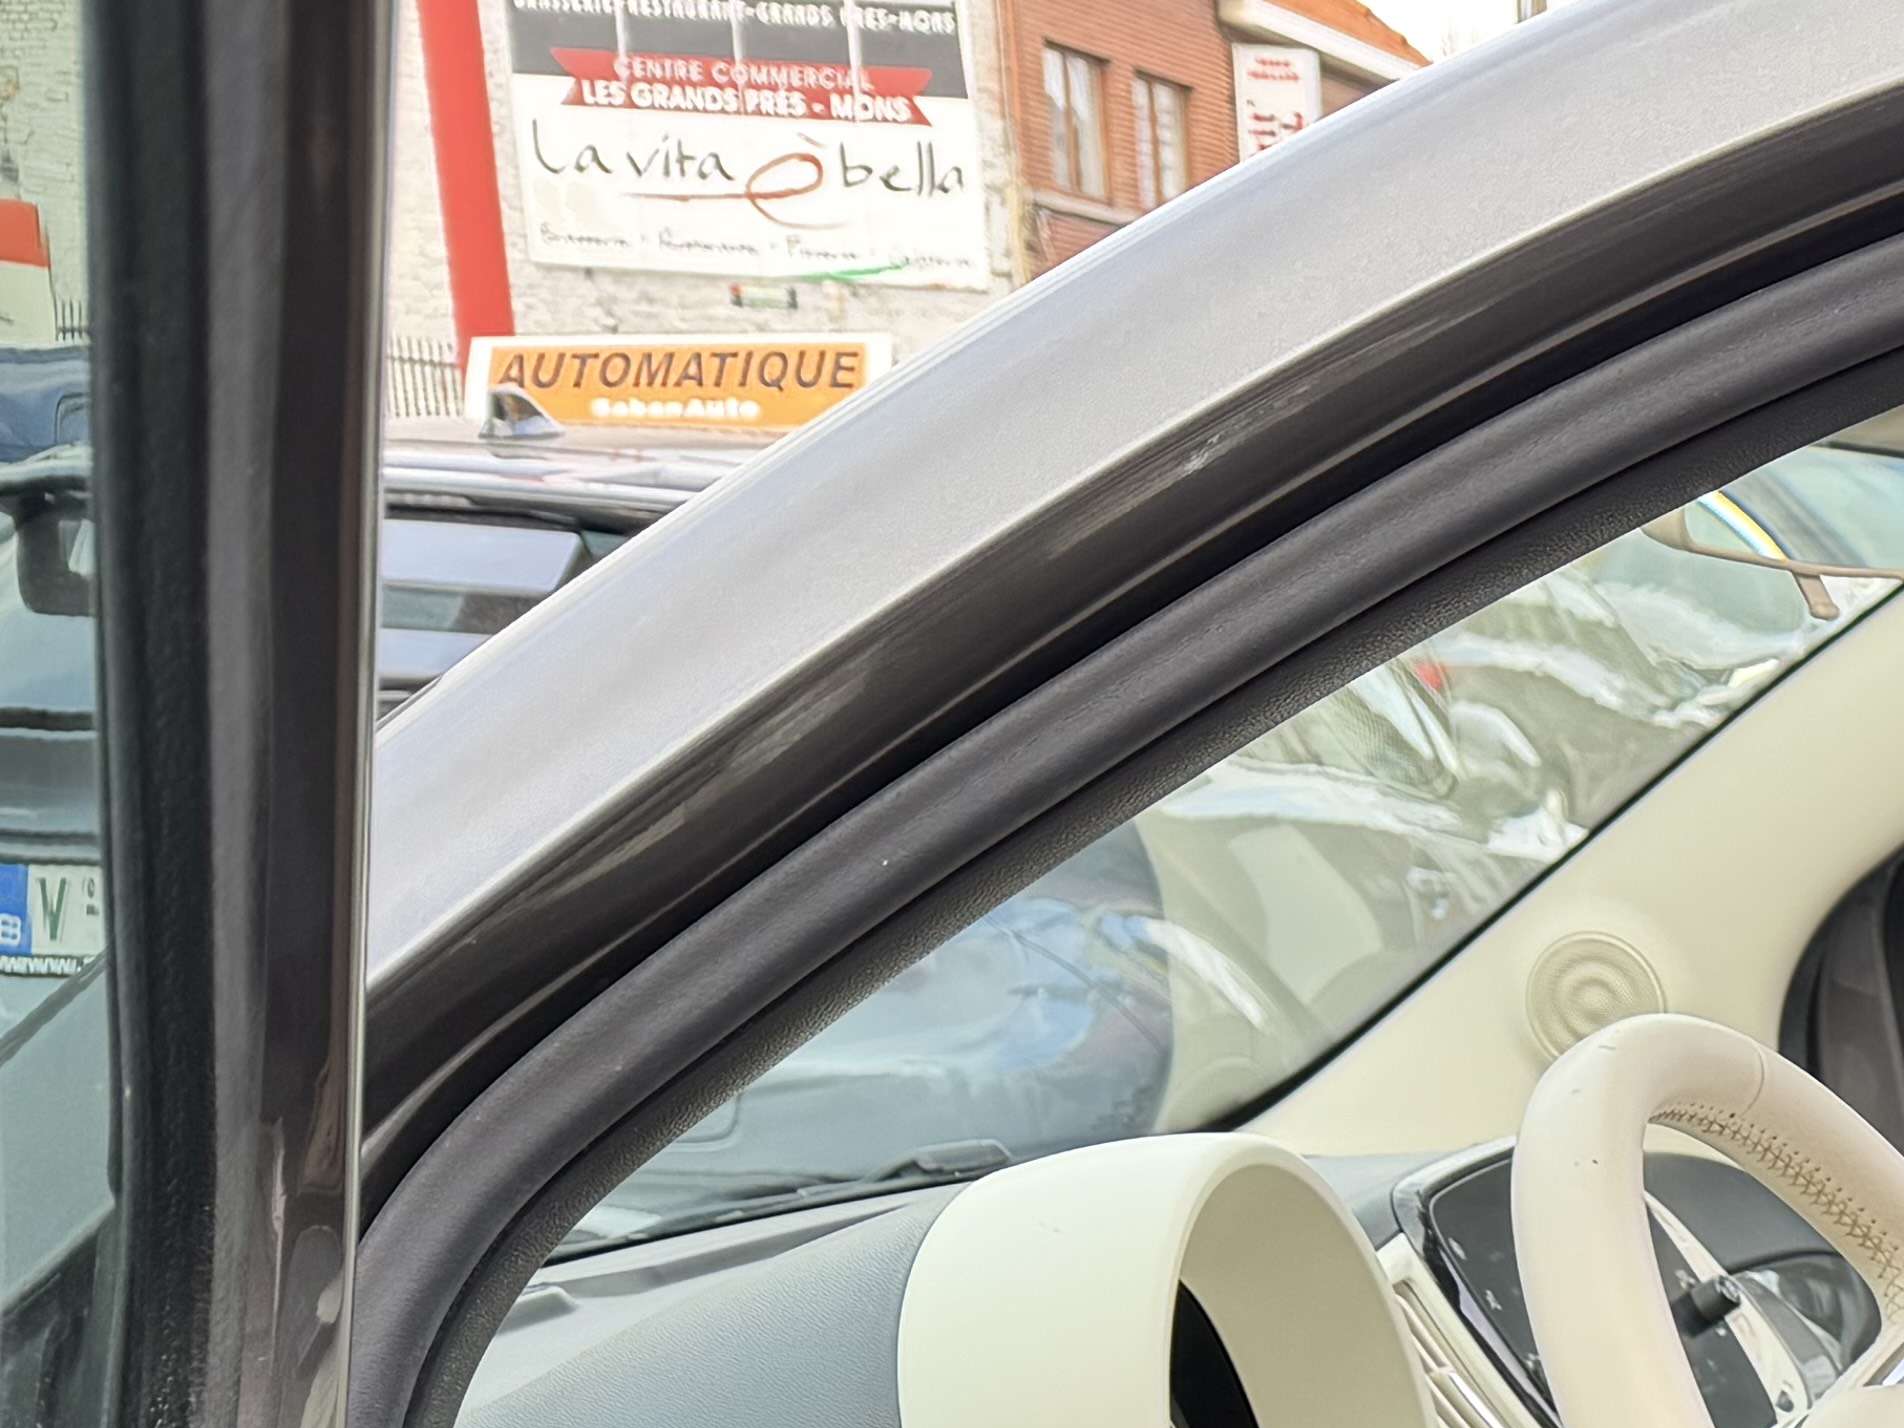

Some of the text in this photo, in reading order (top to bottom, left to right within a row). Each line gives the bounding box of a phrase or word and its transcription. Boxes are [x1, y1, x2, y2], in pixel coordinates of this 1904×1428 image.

[613, 54, 704, 82] CENTRE
[581, 77, 625, 106] LES
[630, 81, 738, 112] GRANDS
[830, 94, 911, 123] MONS
[625, 133, 734, 181] vita
[840, 141, 964, 197] bella
[499, 350, 860, 391] AUTOMATIQUE
